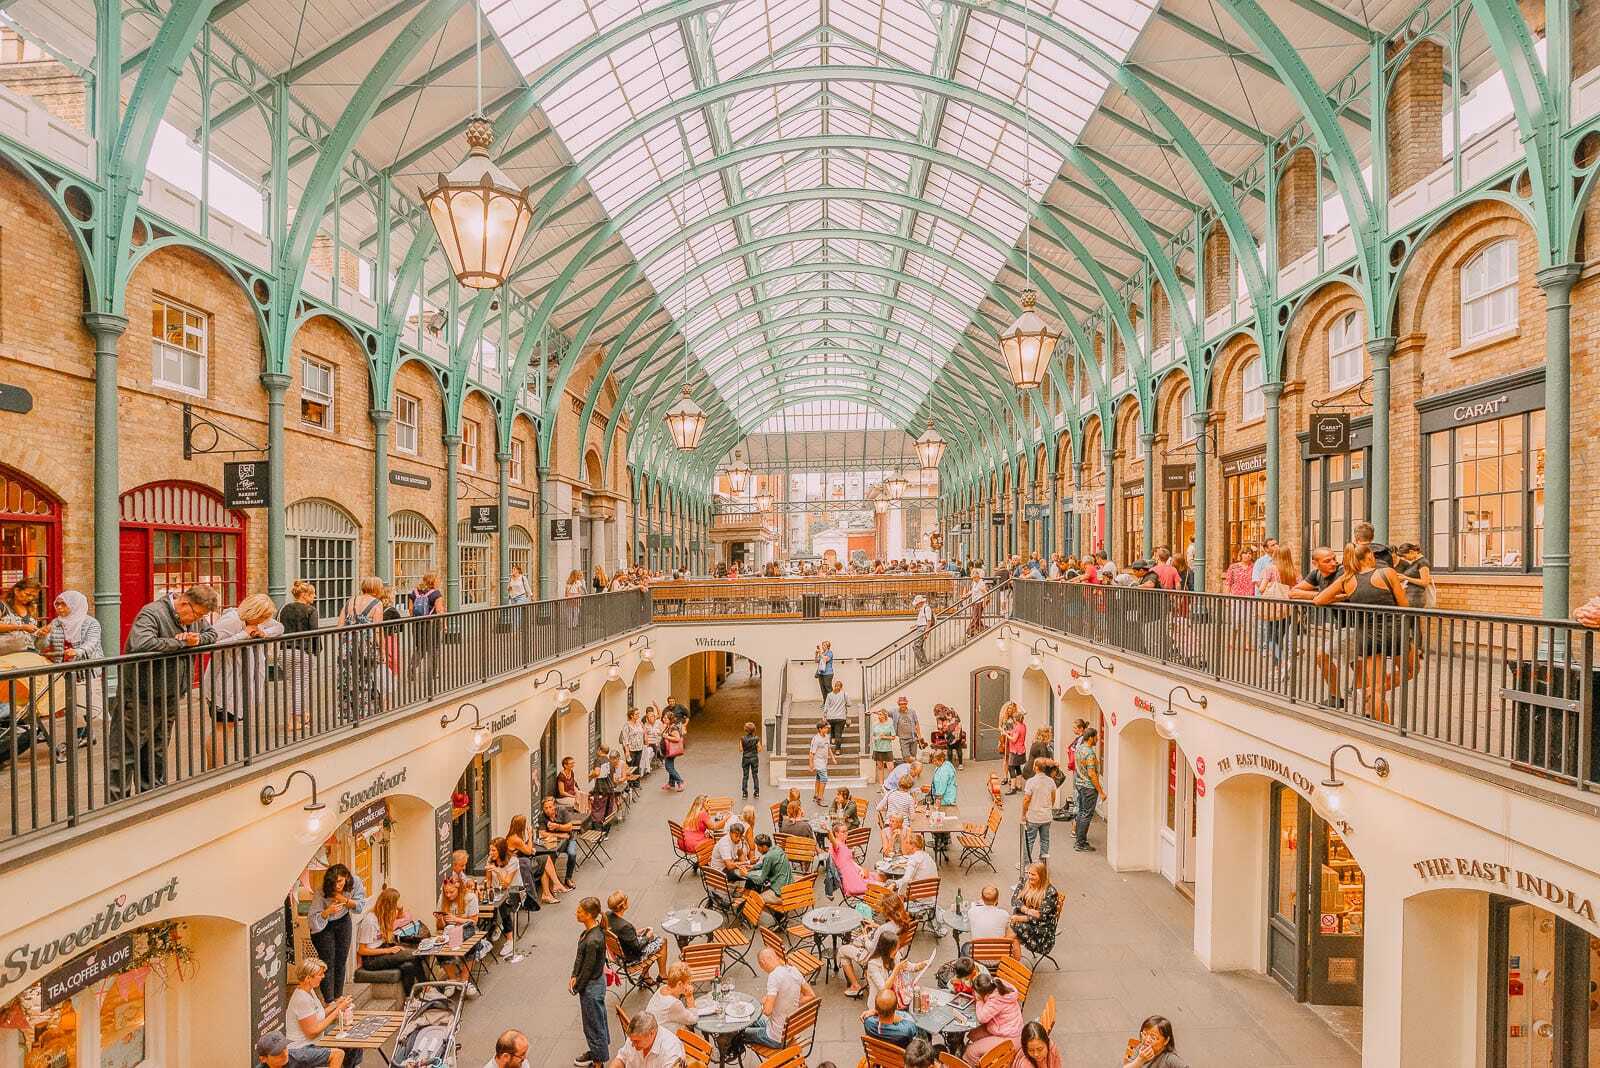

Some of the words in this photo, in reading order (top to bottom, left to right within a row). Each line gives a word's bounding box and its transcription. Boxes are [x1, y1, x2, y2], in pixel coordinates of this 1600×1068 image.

[1454, 400, 1501, 421] CARAT
[1237, 455, 1262, 471] Venchi
[695, 636, 736, 648] Whittard
[491, 710, 517, 734] Italiani
[1236, 753, 1260, 768] EAST
[1260, 756, 1291, 781] INDIA
[339, 766, 407, 815] Sweetheart
[1413, 857, 1454, 879] THE
[1456, 857, 1511, 885] EAST
[1516, 869, 1598, 924] INDIA
[0, 876, 180, 989] Sweetheart
[67, 964, 100, 990] COFFEE
[99, 959, 108, 971] &
[107, 945, 131, 967] LOVE
